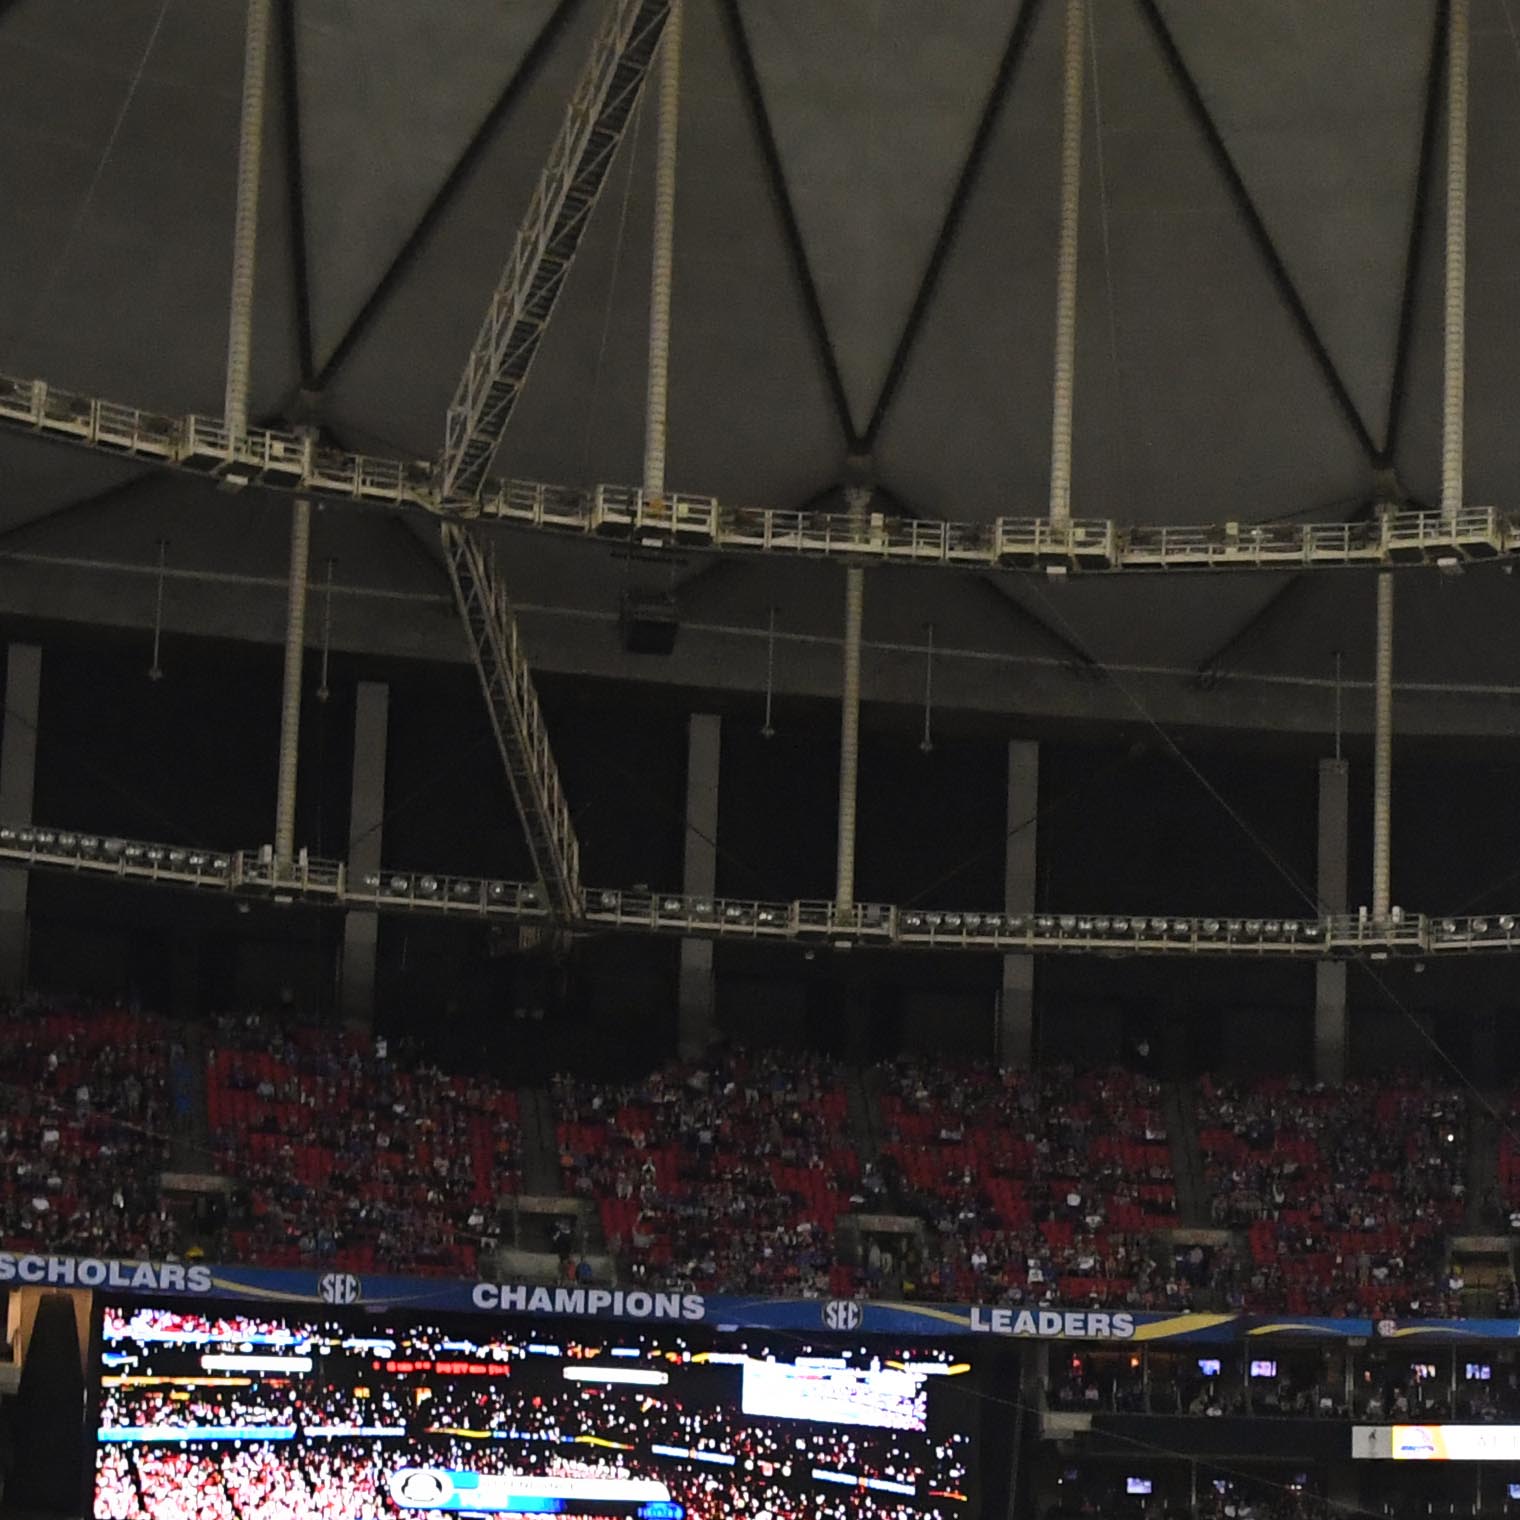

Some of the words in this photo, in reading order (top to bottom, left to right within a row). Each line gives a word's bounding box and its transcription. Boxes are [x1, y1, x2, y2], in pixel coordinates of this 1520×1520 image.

[0, 1253, 212, 1293] SCHOLARS
[319, 1273, 360, 1303] SEC
[471, 1283, 706, 1321] CHAMPIONS
[825, 1301, 860, 1330] SEC
[970, 1307, 1136, 1338] LEADERS
